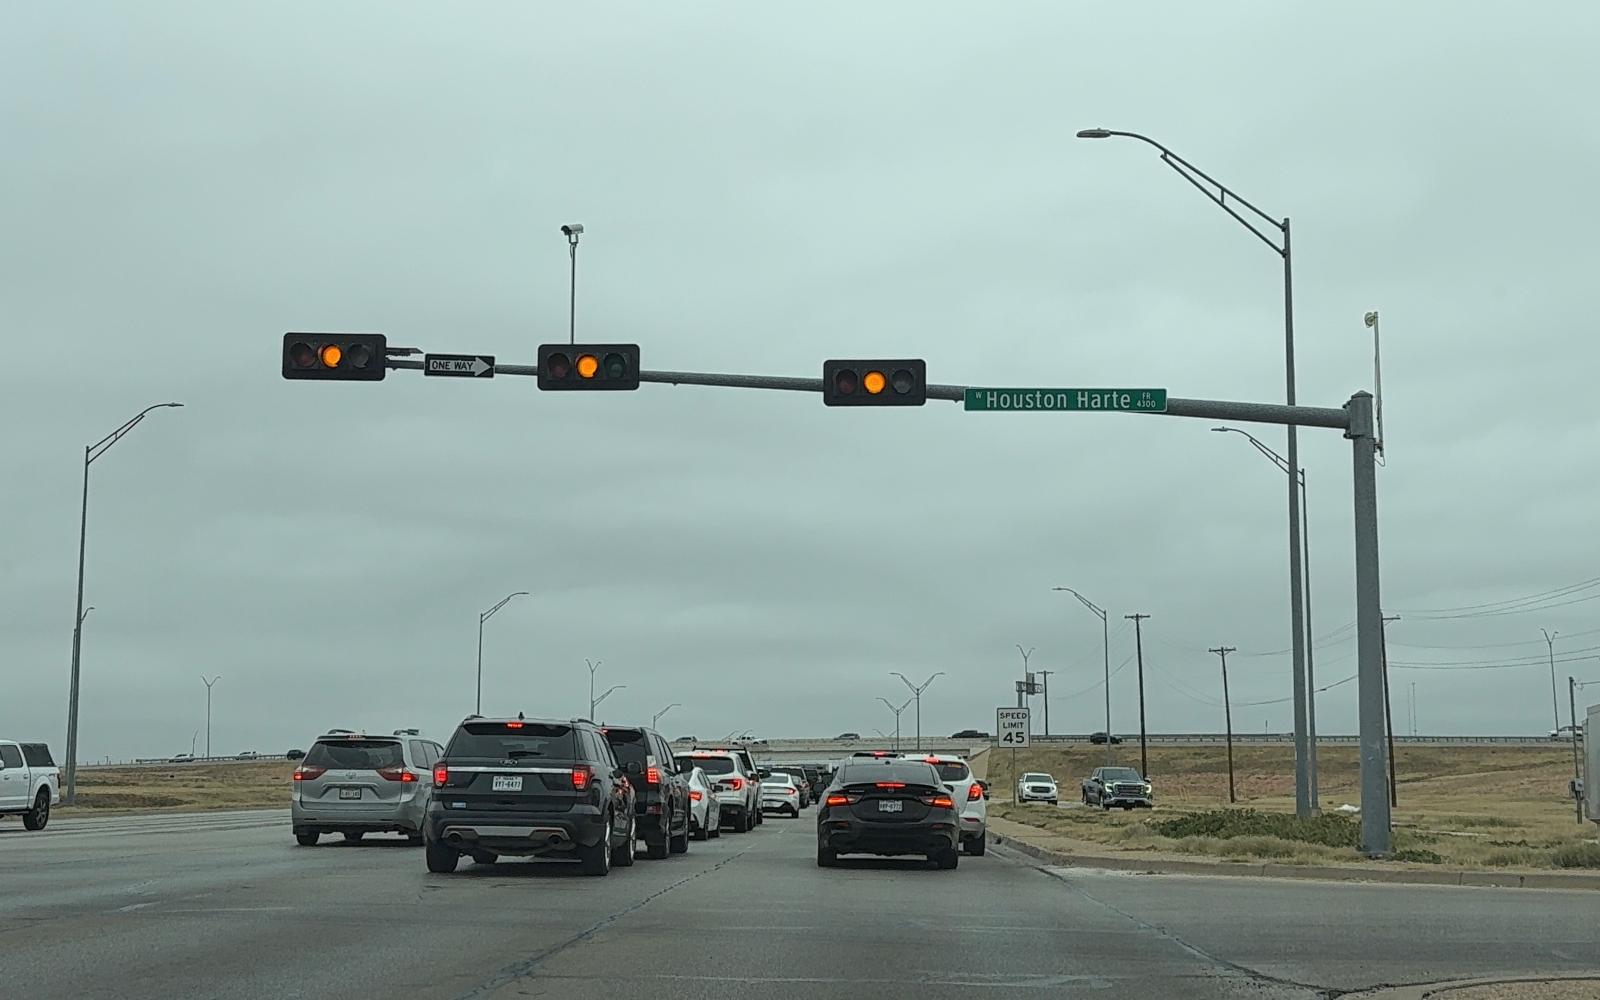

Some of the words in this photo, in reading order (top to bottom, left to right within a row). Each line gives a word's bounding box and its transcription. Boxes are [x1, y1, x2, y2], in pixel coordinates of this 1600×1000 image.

[432, 360, 450, 370] ONE
[454, 361, 474, 371] WAY
[975, 391, 982, 399] W
[986, 391, 1067, 408] Houston
[1077, 391, 1131, 408] Harte
[1142, 391, 1151, 400] FR
[1136, 400, 1156, 408] 4300
[1003, 732, 1025, 744] 45
